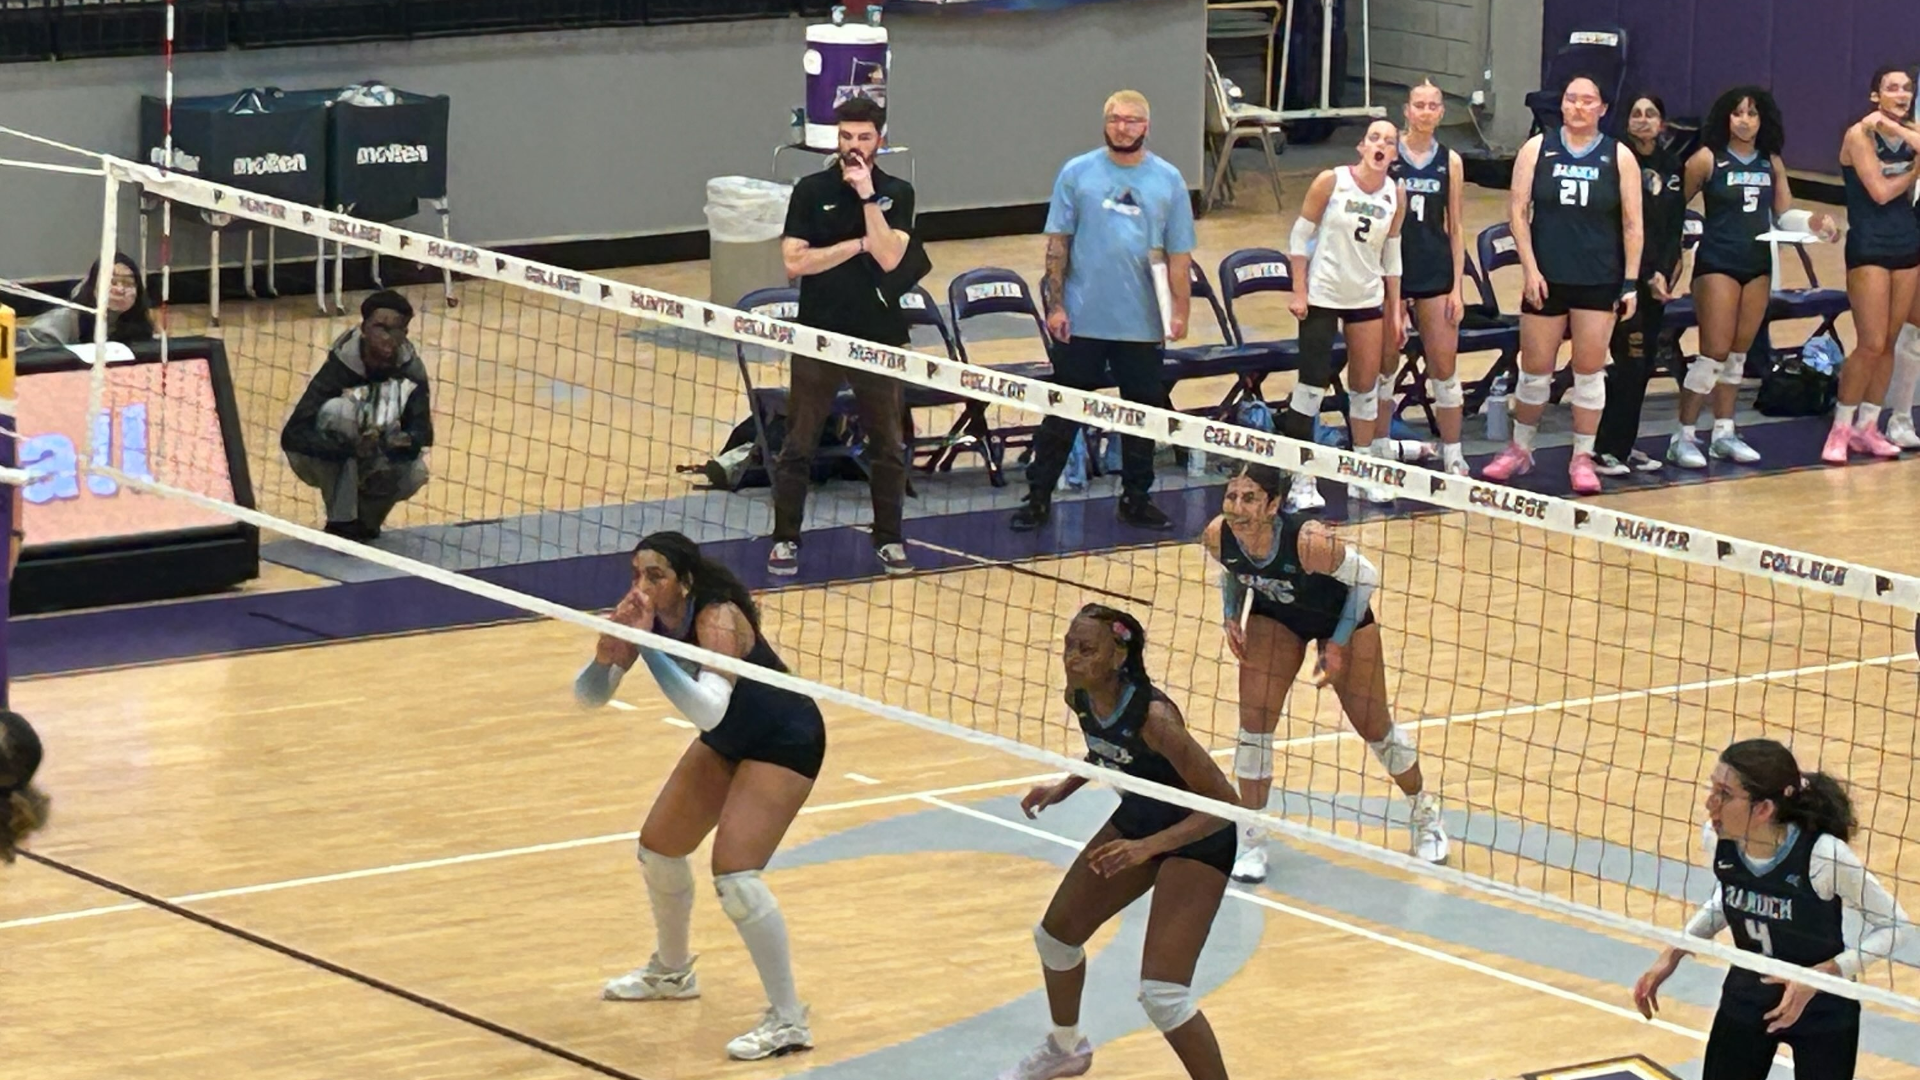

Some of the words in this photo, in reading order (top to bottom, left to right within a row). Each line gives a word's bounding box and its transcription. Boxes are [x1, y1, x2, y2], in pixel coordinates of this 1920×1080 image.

[233, 153, 307, 175] molten
[356, 143, 428, 165] molten
[1559, 179, 1589, 207] 21
[1742, 187, 1760, 212] 5
[1410, 194, 1425, 222] 9
[1354, 216, 1372, 243] 2
[1203, 425, 1277, 457] COLLEGE
[1337, 455, 1407, 488] HUNTER
[1469, 485, 1549, 520] COLLEGE
[1614, 517, 1690, 551] HUNTER
[1760, 550, 1849, 586] COLLEGE
[1745, 919, 1773, 956] 4
